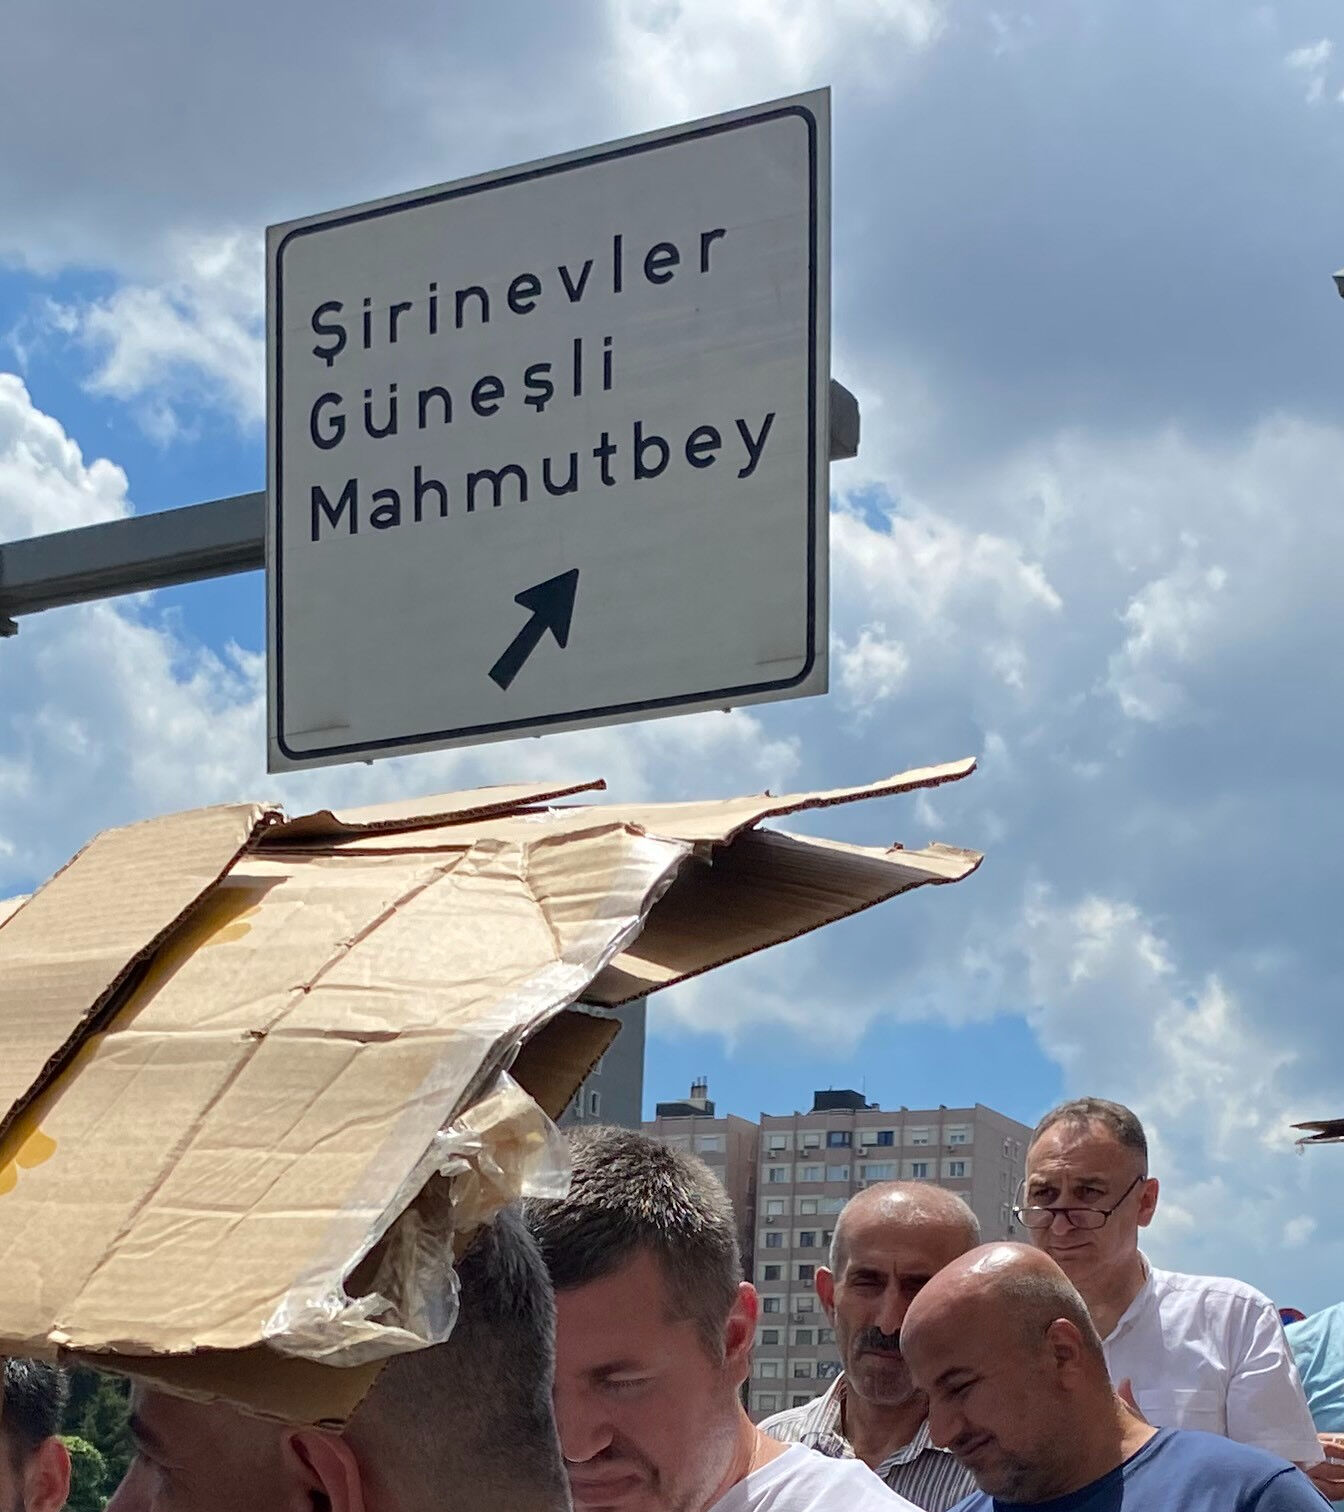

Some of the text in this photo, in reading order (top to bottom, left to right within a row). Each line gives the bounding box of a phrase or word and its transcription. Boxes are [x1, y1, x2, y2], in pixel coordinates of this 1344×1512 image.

[311, 228, 726, 367] Şirinevler
[310, 336, 613, 450] Güneşli
[311, 412, 776, 541] Mahmutbey
